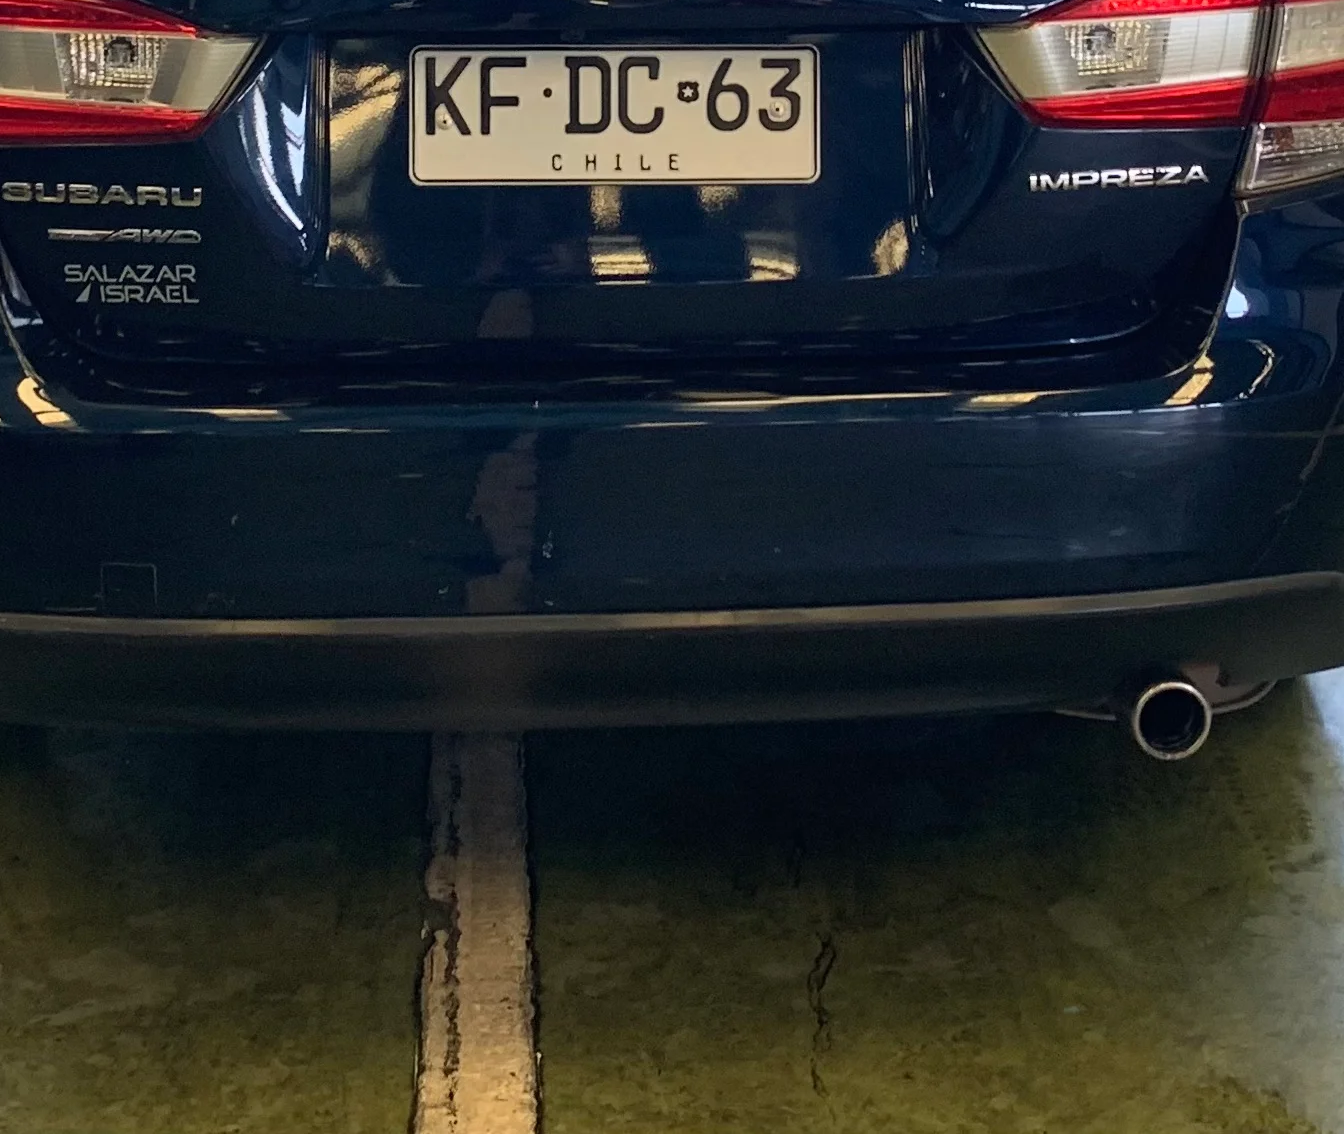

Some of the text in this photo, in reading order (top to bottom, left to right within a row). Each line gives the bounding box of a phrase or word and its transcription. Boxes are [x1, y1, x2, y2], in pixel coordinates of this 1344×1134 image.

[551, 154, 680, 172] CHILE
[1029, 164, 1209, 193] IMPREZA
[1, 181, 203, 208] SUBARU
[106, 227, 202, 244] AWD
[64, 264, 196, 283] SALAZAR
[100, 284, 200, 304] ISRAEL
